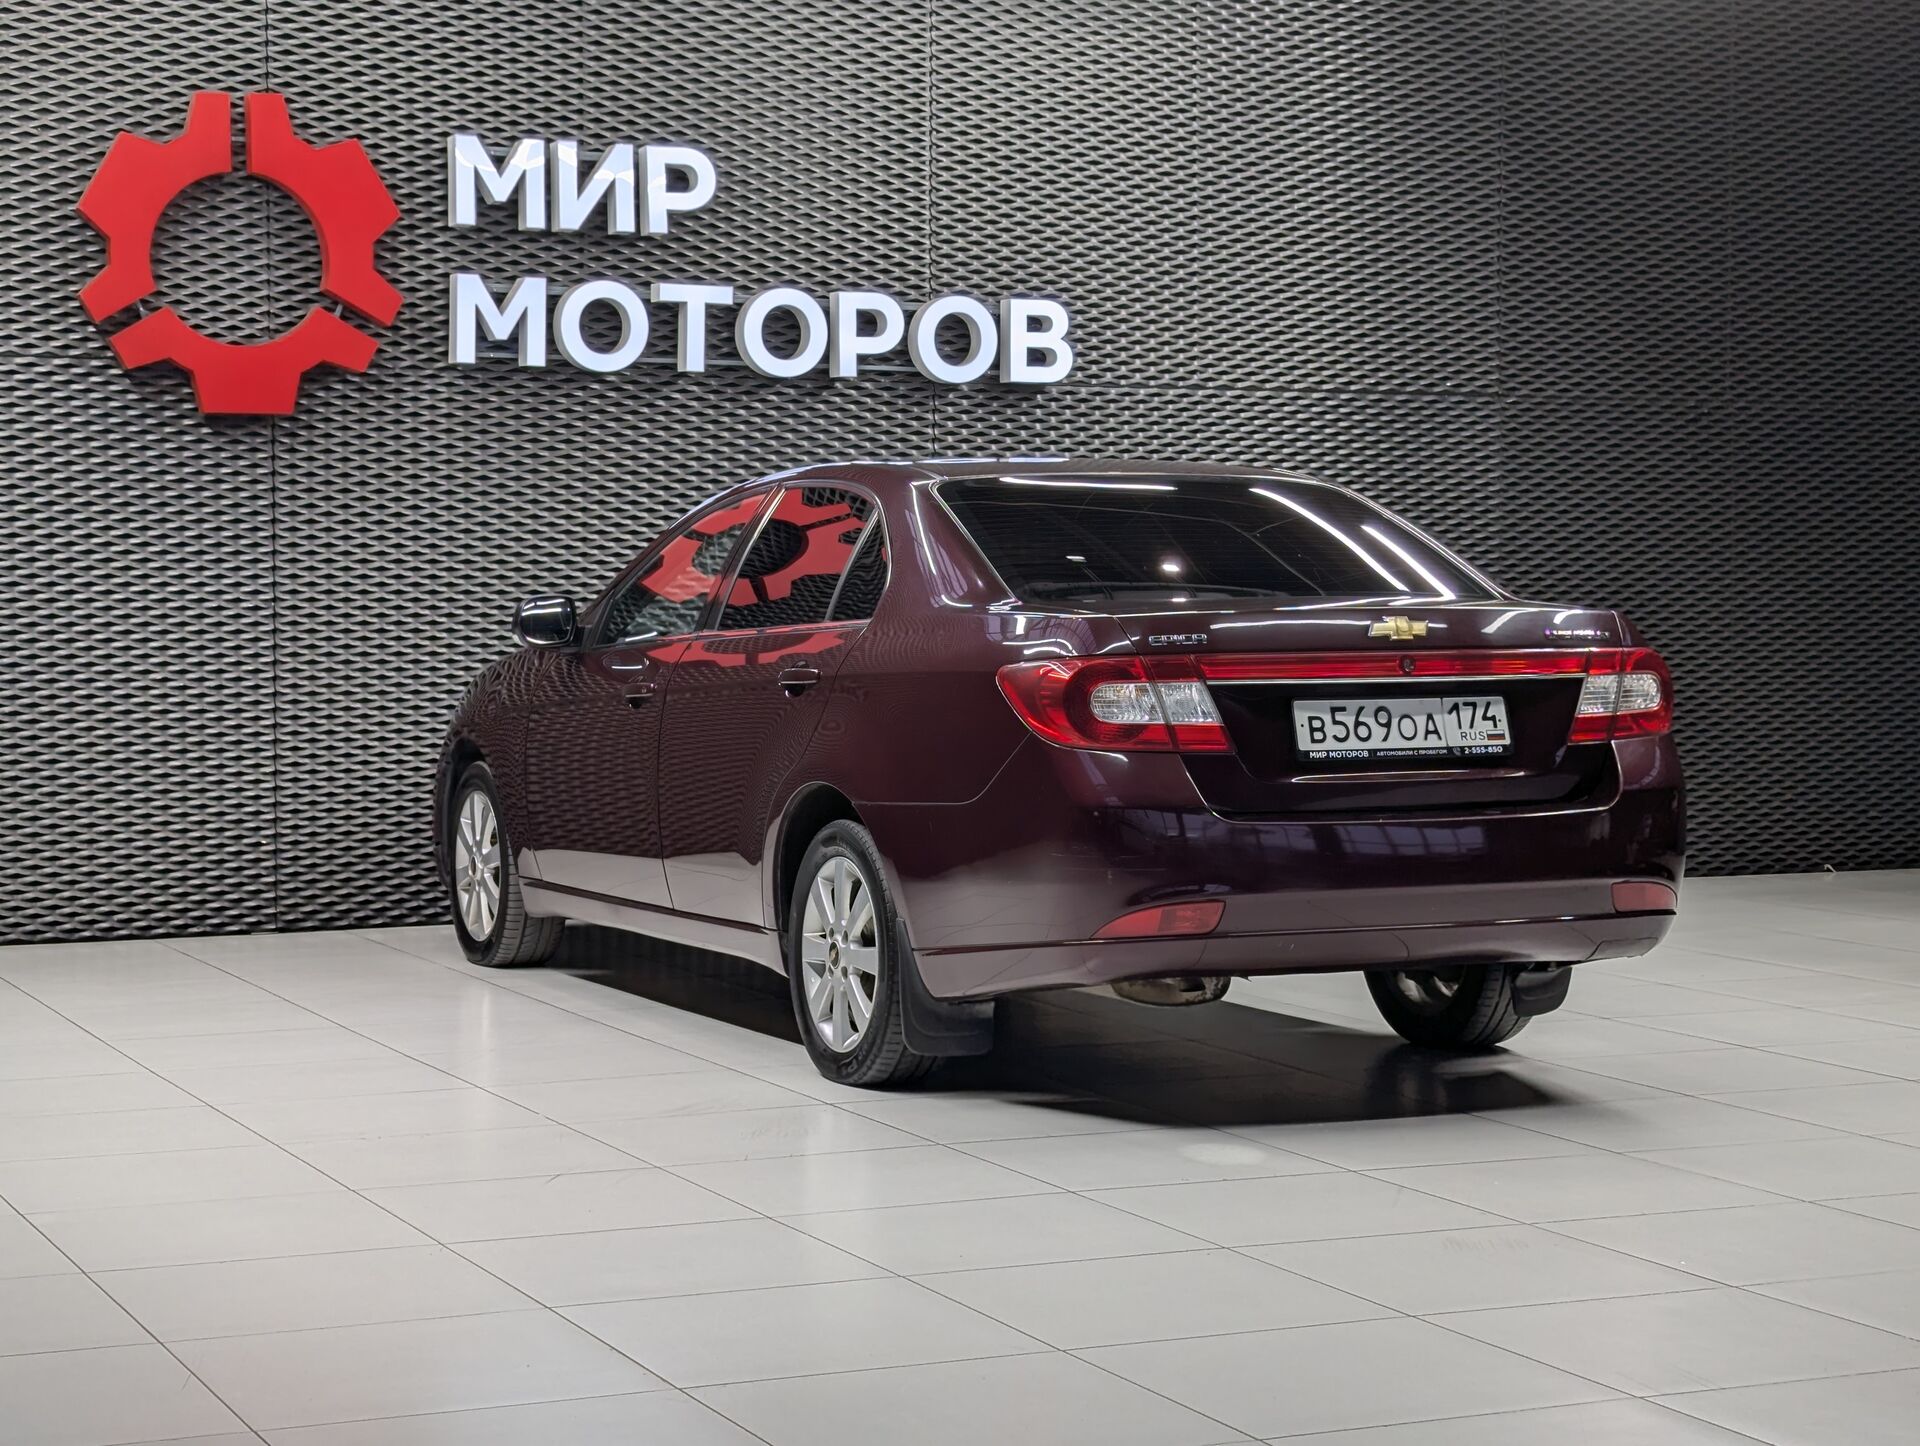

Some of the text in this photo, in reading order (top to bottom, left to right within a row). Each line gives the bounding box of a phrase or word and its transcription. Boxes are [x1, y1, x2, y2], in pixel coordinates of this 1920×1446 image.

[447, 133, 717, 236] МИР
[448, 272, 1074, 384] МОТОРОВ
[1307, 705, 1443, 744] В569ОА
[1447, 701, 1498, 730] 174
[1460, 730, 1486, 741] RUS
[1309, 750, 1369, 759] МИР МОТОРОВ
